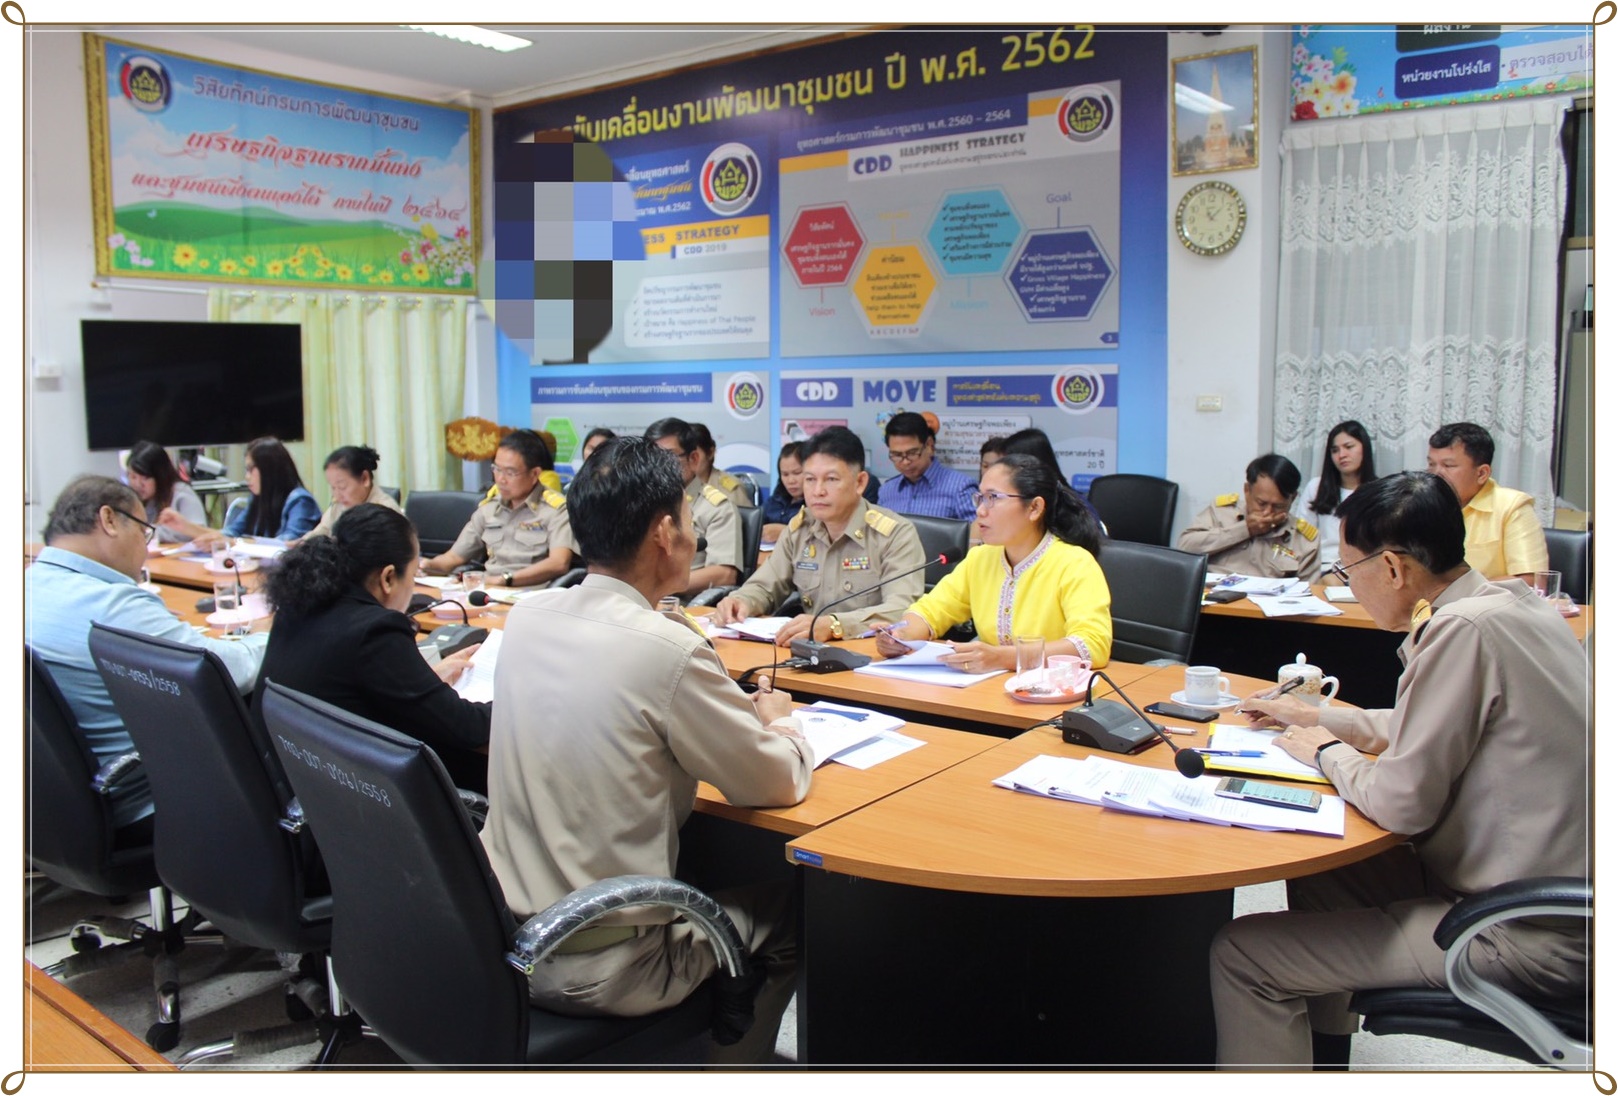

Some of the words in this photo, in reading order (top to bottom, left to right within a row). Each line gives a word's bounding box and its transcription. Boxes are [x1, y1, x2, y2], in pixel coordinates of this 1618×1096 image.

[535, 68, 873, 142] ขับเคลื่อนงานพัฒนาชุมชน
[885, 52, 906, 90] ปี
[921, 46, 986, 85] พ.ศ.
[1001, 24, 1095, 72] 2562
[1401, 60, 1492, 84] หน่วยงานโปร่งใส
[1509, 42, 1592, 71] ตรวจสอบได้
[192, 74, 421, 134] วิสัยทัศน์กรมการพัฒนาชุมชน
[158, 124, 424, 178] เศรษฐกิจฐานรากมั่นคง
[796, 121, 925, 152] ยุทธศาสตร์กรมการพัฒนาชุมชน
[985, 109, 1011, 121] 2564
[853, 153, 893, 176] CDD
[899, 140, 960, 158] HAPPINESS
[966, 132, 1027, 150] STRATEGY
[131, 172, 330, 208] และชุมชนพึ่งตนเองได้
[332, 187, 391, 214] ภายในปี
[401, 197, 469, 222] ๒๕๖๔
[1046, 191, 1072, 205] Goal
[675, 224, 740, 241] STRATEGY
[809, 306, 836, 317] Vision
[795, 381, 839, 402] CDD
[863, 379, 936, 403] MOVE
